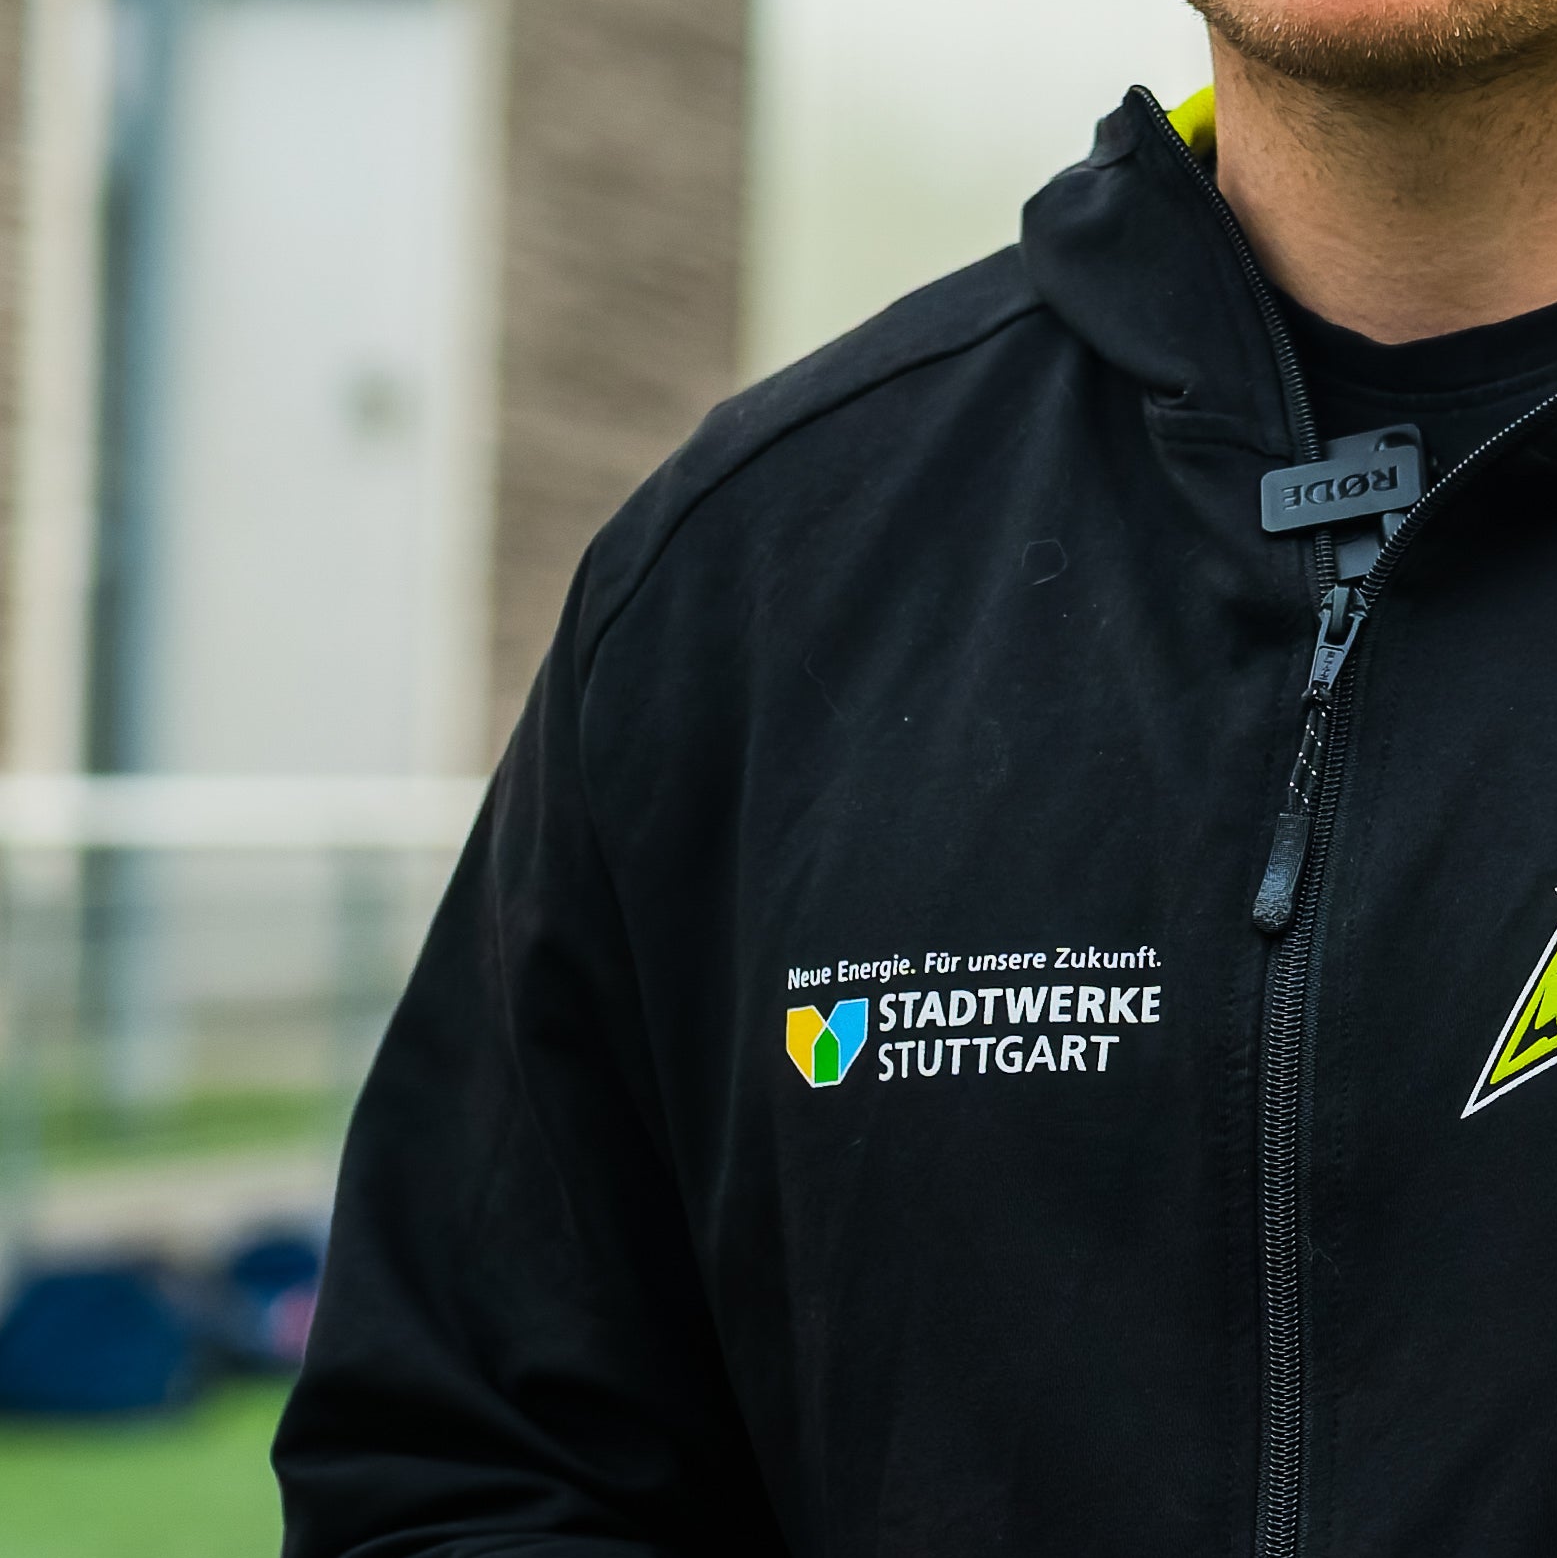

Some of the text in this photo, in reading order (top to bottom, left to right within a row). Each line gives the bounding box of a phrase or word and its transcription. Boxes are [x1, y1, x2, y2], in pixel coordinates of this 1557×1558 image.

[1281, 465, 1398, 510] RØDE
[787, 946, 1162, 990] Neue Energie. Für unsere Zukunft.
[879, 986, 1161, 1032] STADTWERKE
[878, 1035, 1120, 1082] STUTTGART
